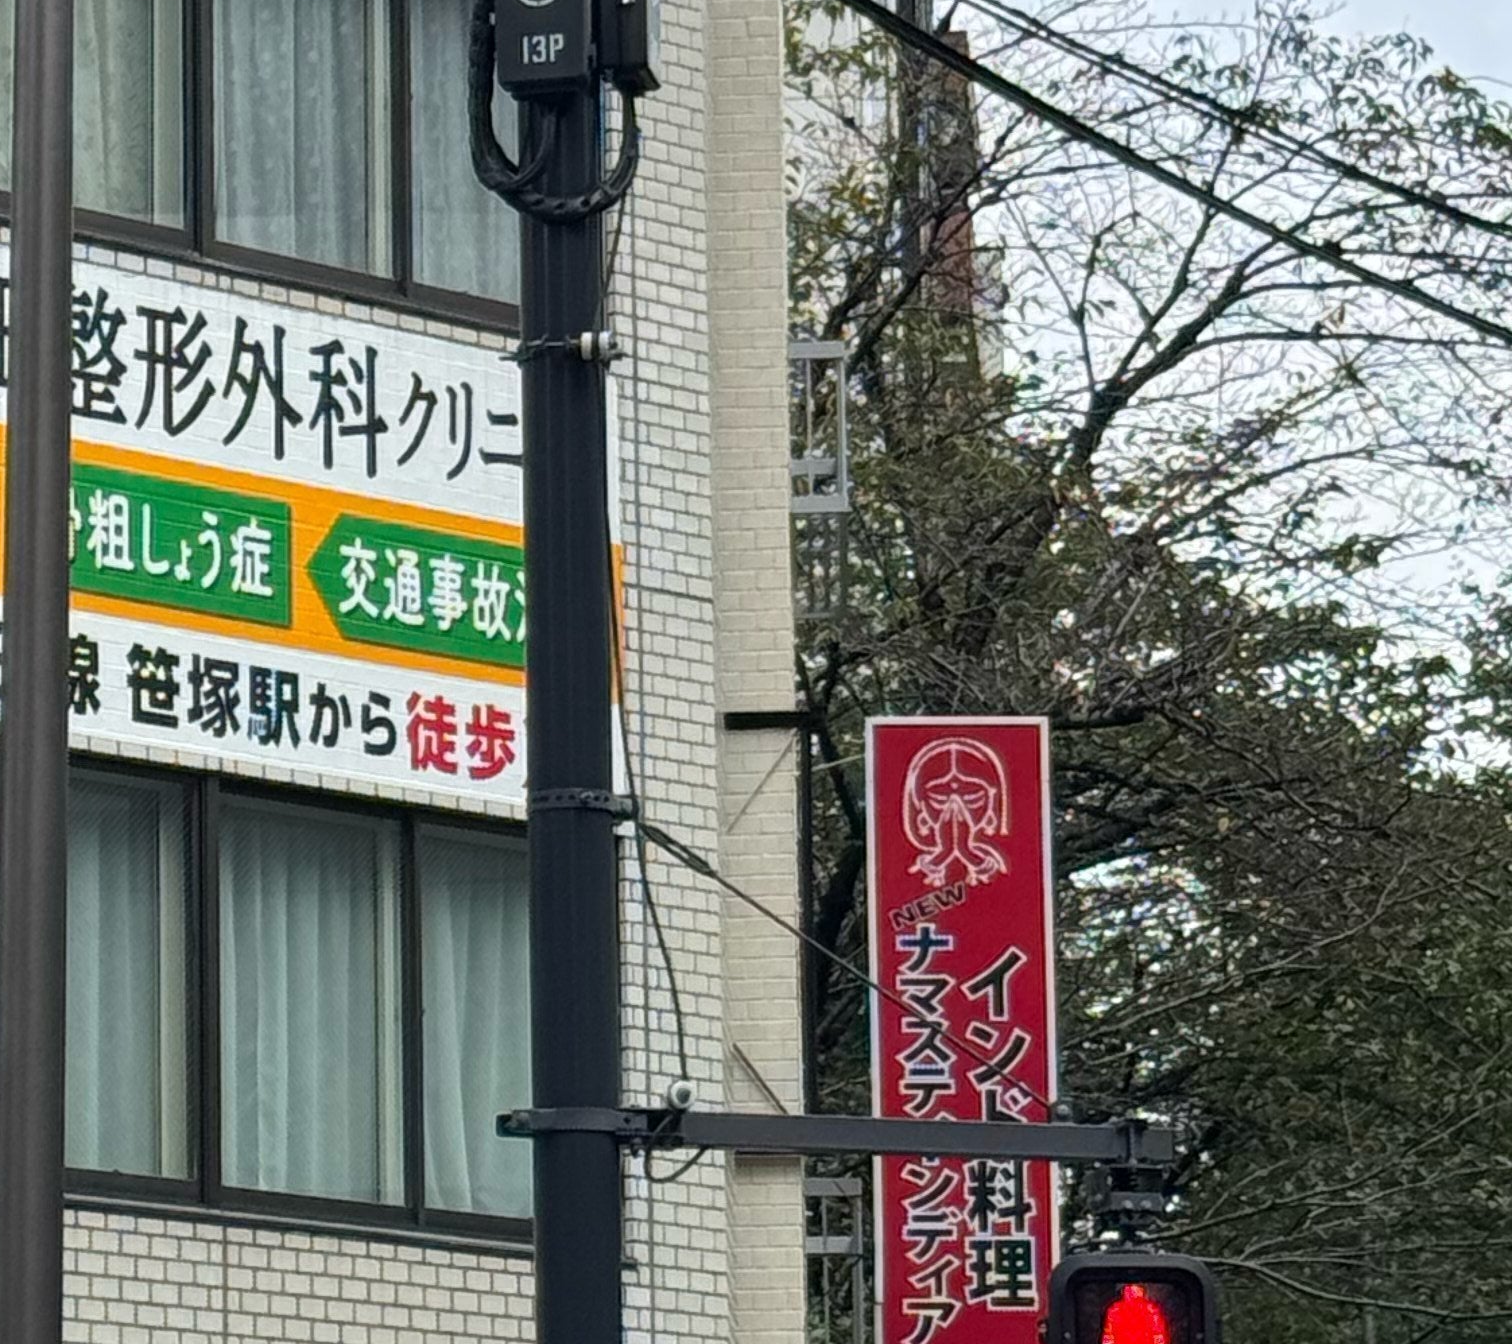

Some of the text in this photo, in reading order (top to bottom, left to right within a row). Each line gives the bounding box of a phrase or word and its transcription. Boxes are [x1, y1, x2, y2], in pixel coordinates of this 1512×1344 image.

[70, 488, 273, 597] 粗しょう症
[339, 537, 524, 643] 交通事故
[890, 881, 966, 930] NEW
